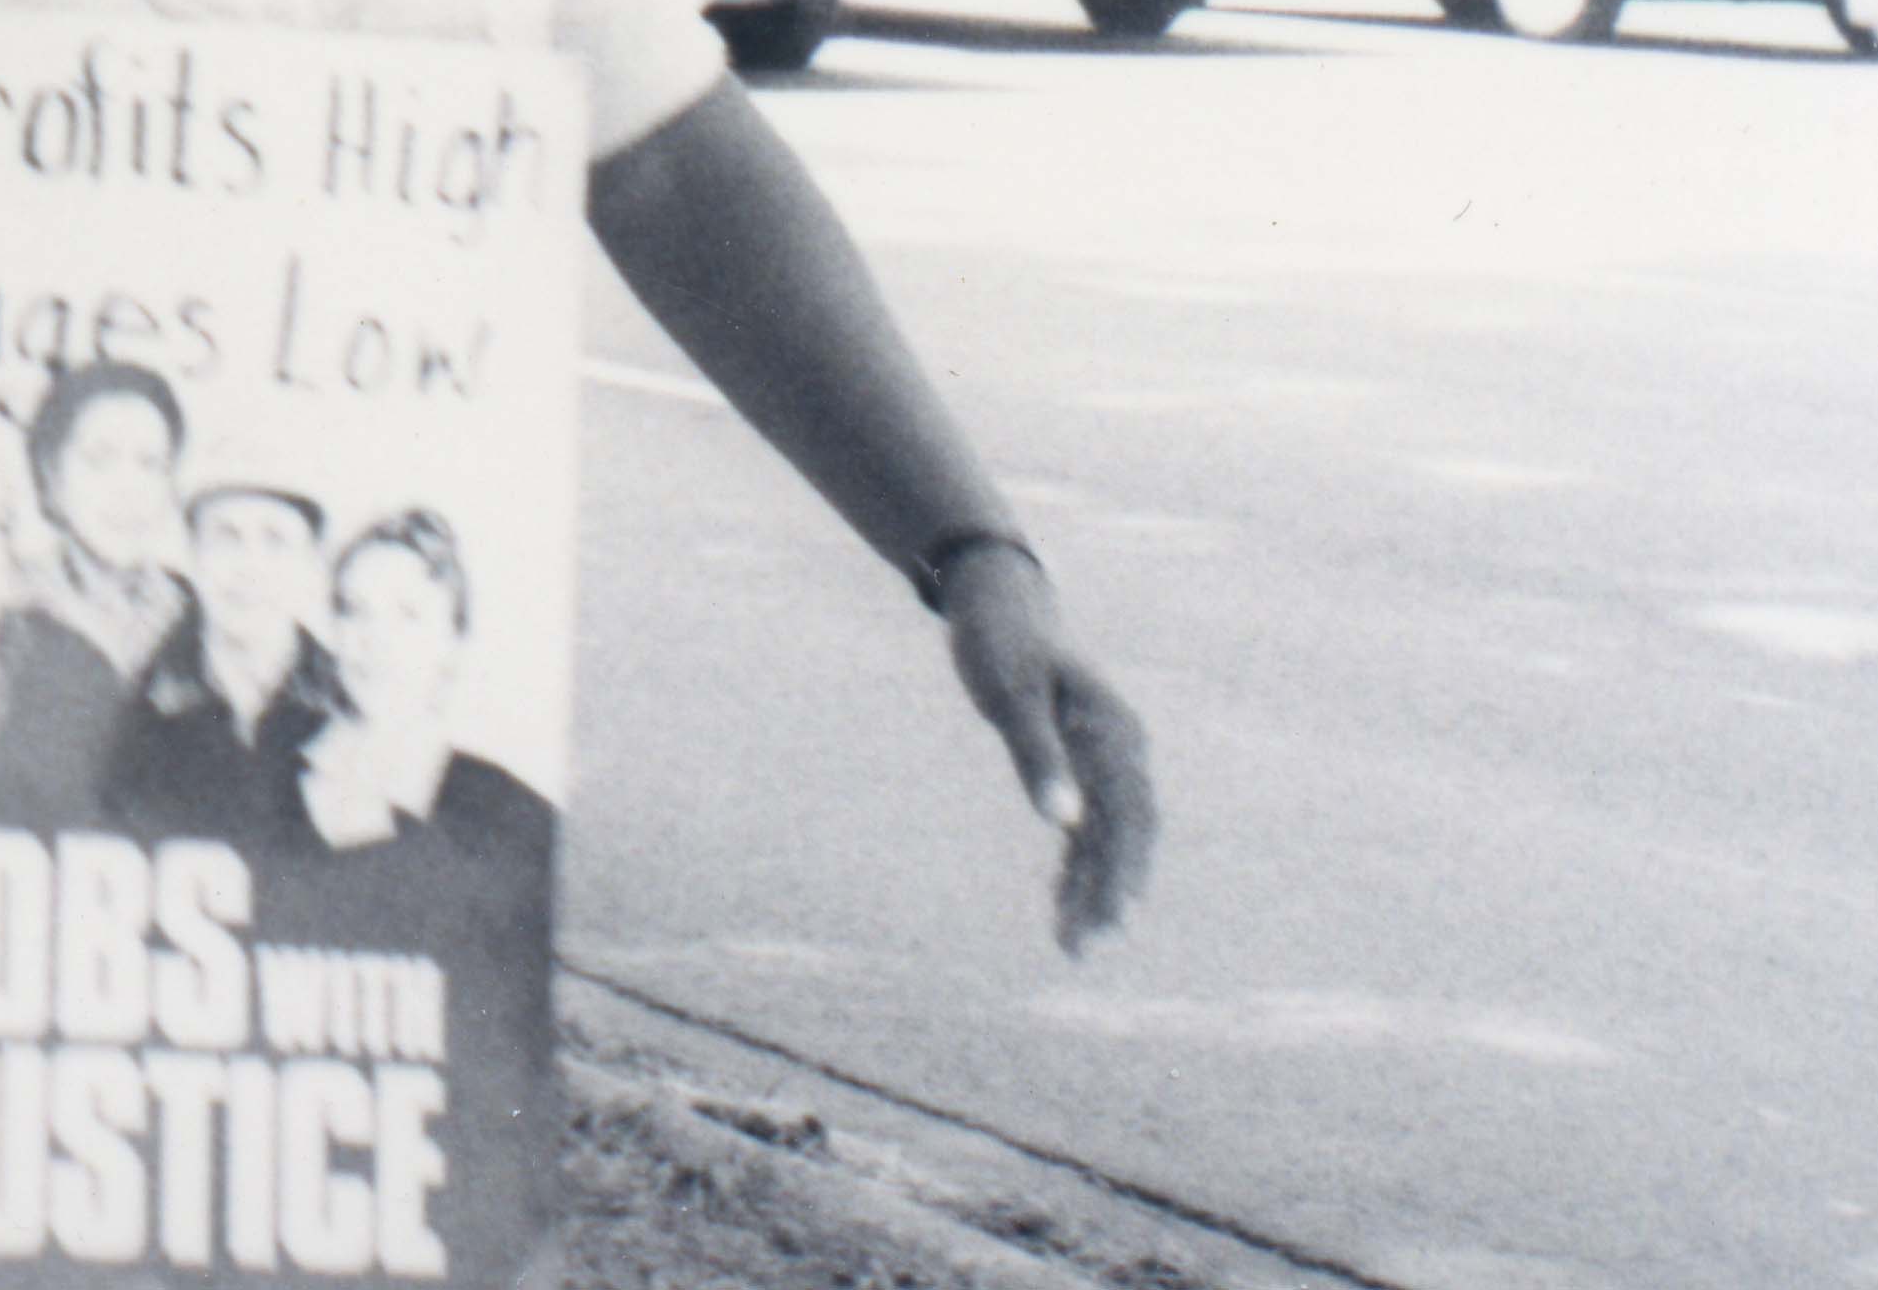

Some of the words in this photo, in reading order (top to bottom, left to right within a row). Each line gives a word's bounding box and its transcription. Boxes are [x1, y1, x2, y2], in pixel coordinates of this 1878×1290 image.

[318, 71, 548, 249] High
[271, 251, 497, 401] Low
[251, 941, 447, 1063] WITH
